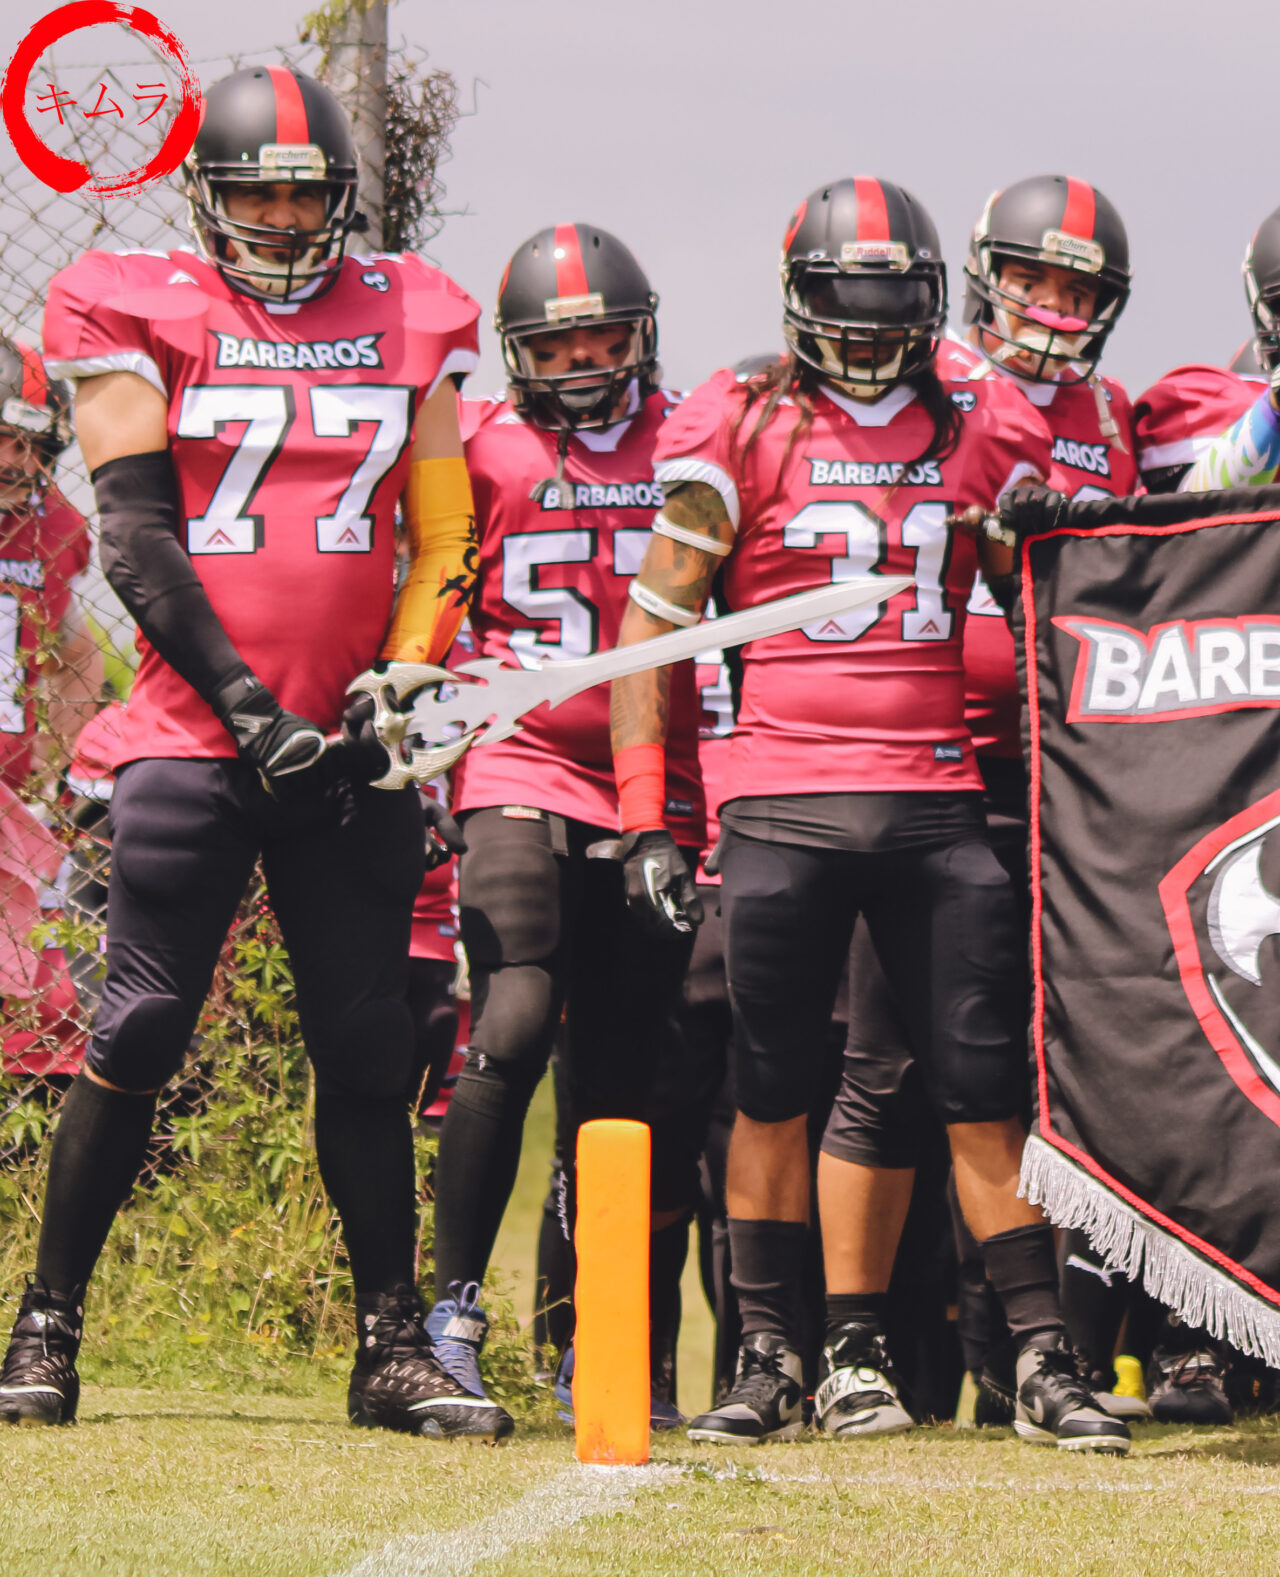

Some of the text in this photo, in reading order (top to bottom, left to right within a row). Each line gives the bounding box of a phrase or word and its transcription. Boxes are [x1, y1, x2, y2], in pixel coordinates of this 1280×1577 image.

[217, 332, 380, 369] BARBAROS
[177, 384, 418, 554] 77
[544, 484, 666, 509] BRBAROS
[784, 501, 954, 641] 31
